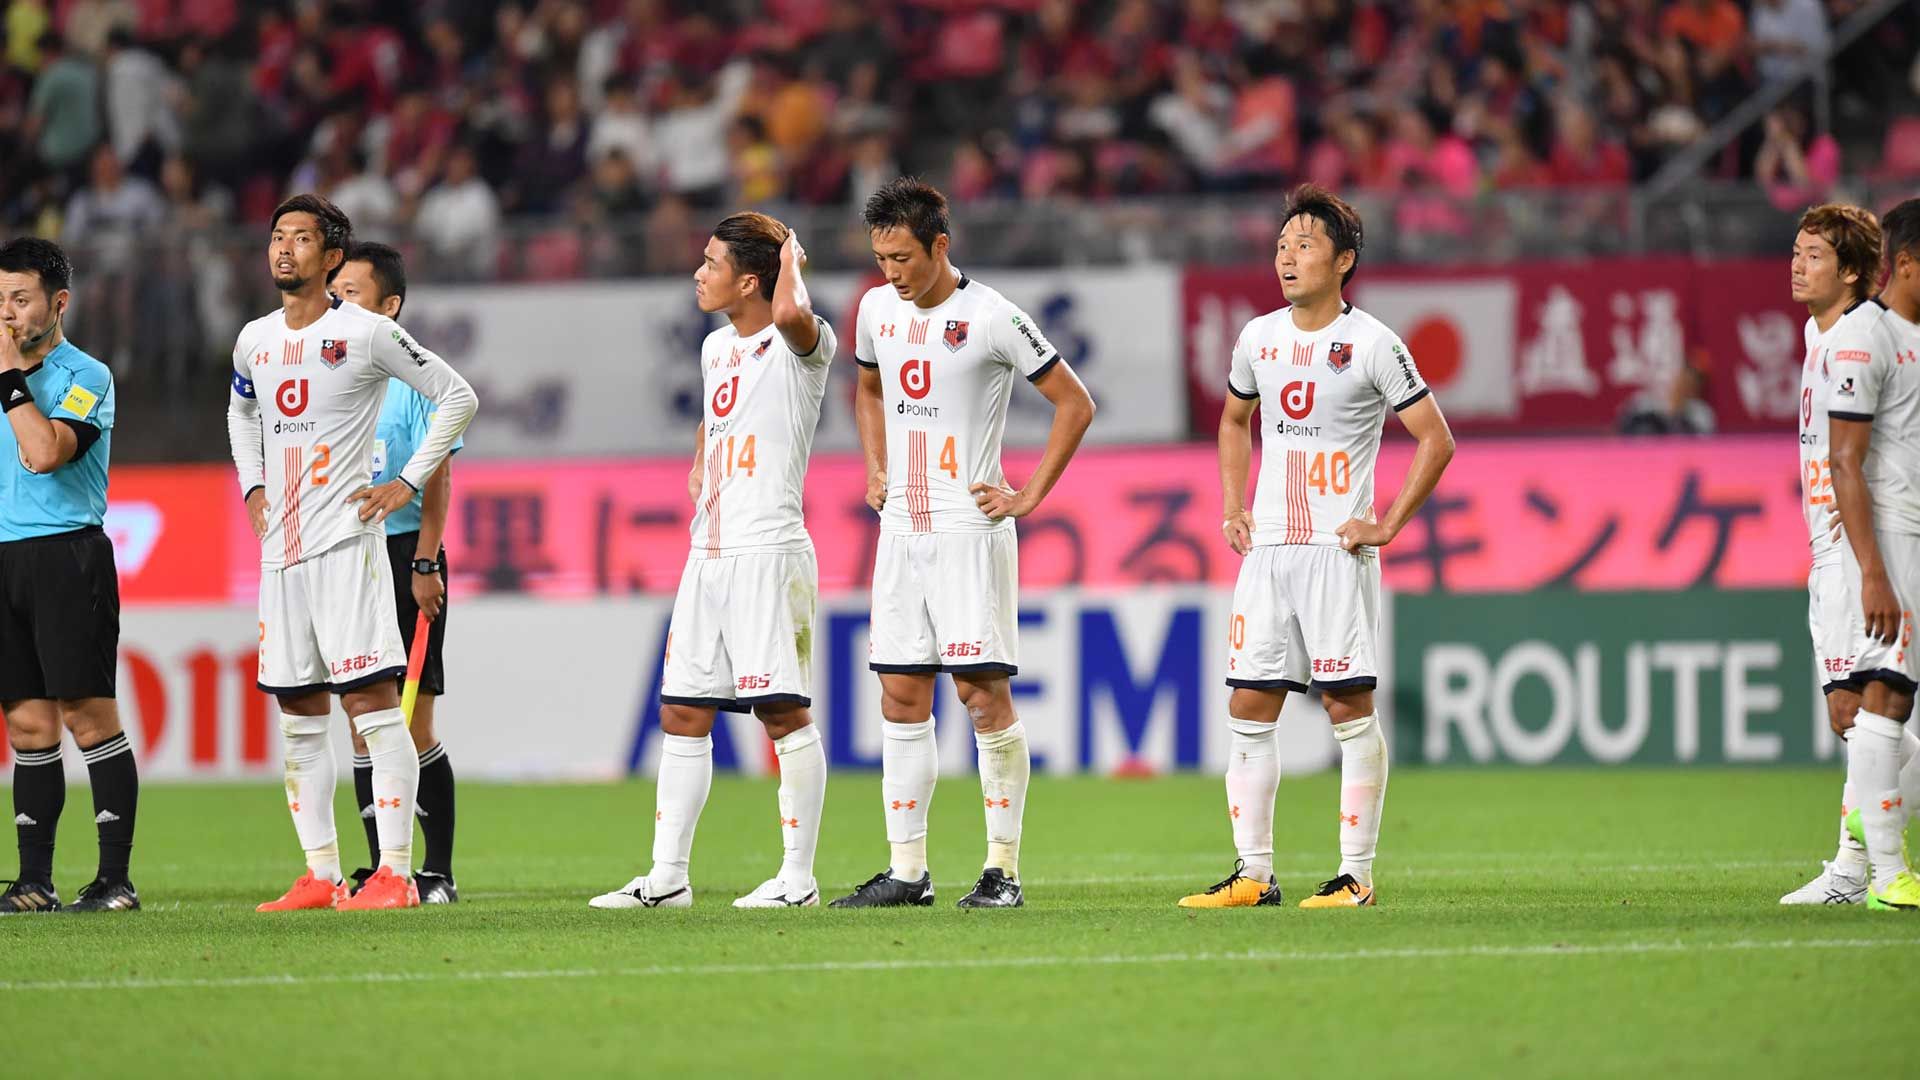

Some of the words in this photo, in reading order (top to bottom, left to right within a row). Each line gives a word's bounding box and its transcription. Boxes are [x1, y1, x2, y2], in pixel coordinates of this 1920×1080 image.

[312, 445, 330, 485] 2
[727, 435, 756, 477] 14
[940, 436, 958, 480] 4
[1308, 452, 1350, 496] 40
[331, 651, 378, 675] しまむら
[735, 674, 771, 690] まむら
[1313, 657, 1351, 673] まむら
[1424, 640, 1782, 763] ROUTE
